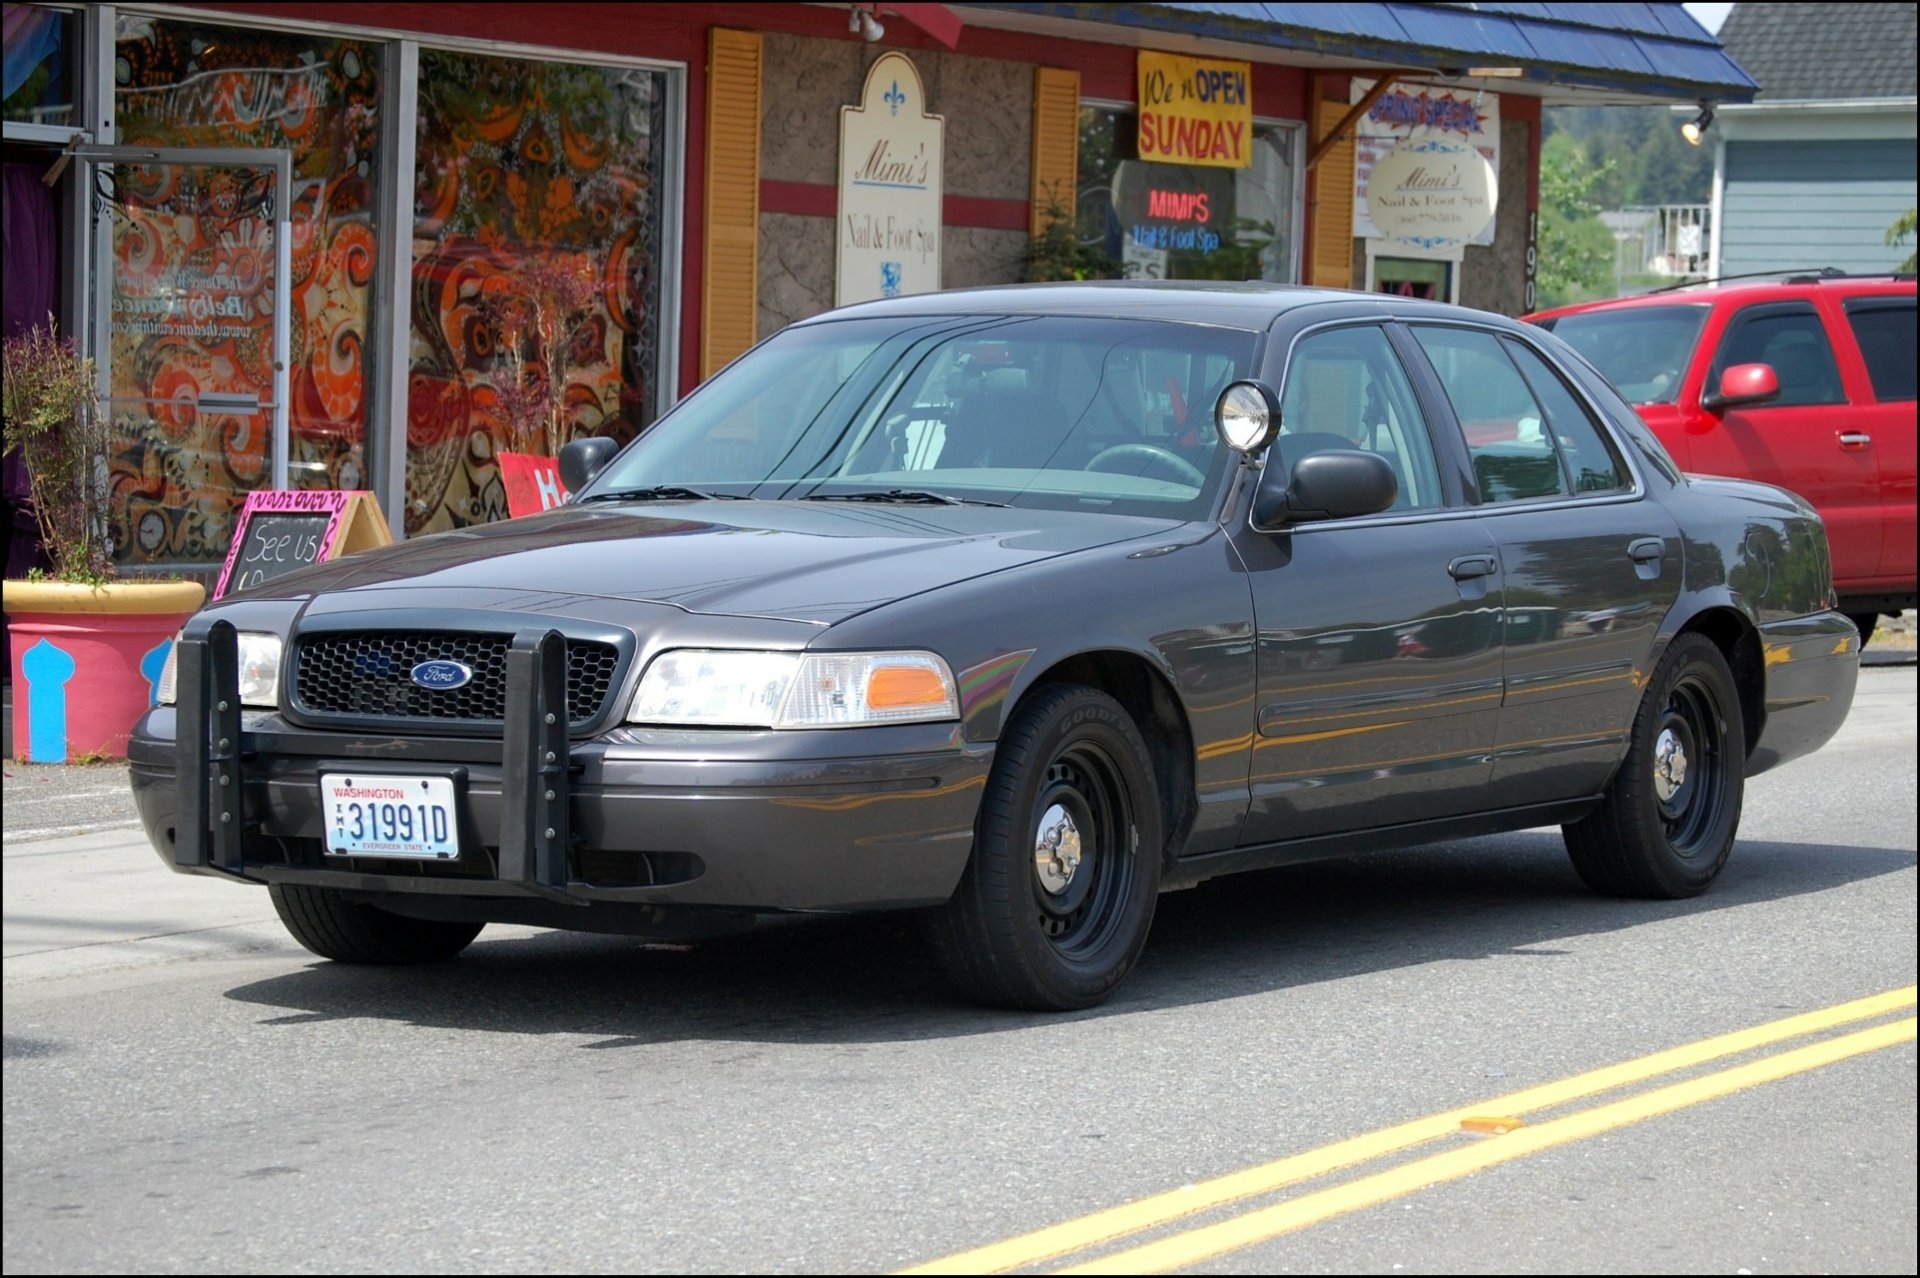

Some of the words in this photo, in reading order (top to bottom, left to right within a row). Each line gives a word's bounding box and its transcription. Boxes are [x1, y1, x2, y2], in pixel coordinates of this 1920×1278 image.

[1195, 68, 1246, 106] OPEN
[1140, 112, 1245, 160] SUNDAY
[854, 138, 929, 184] Mimi's
[1396, 164, 1462, 188] Mimi's
[1148, 188, 1210, 223] MIMI'S
[1378, 195, 1406, 208] Nail
[1409, 197, 1420, 208] &
[1426, 195, 1456, 208] Foot
[1462, 194, 1484, 210] Spa
[847, 213, 871, 250] Nail
[873, 217, 884, 250] &
[886, 215, 913, 251] Foot
[916, 217, 935, 266] Spa
[1196, 226, 1220, 256] Spa
[1525, 212, 1537, 310] 190
[246, 524, 291, 563] See
[423, 665, 456, 682] Ford
[333, 787, 404, 800] WASHINGTON
[348, 802, 448, 843] 31991D
[362, 842, 401, 851] EVERGREEN
[404, 844, 424, 852] STATE
